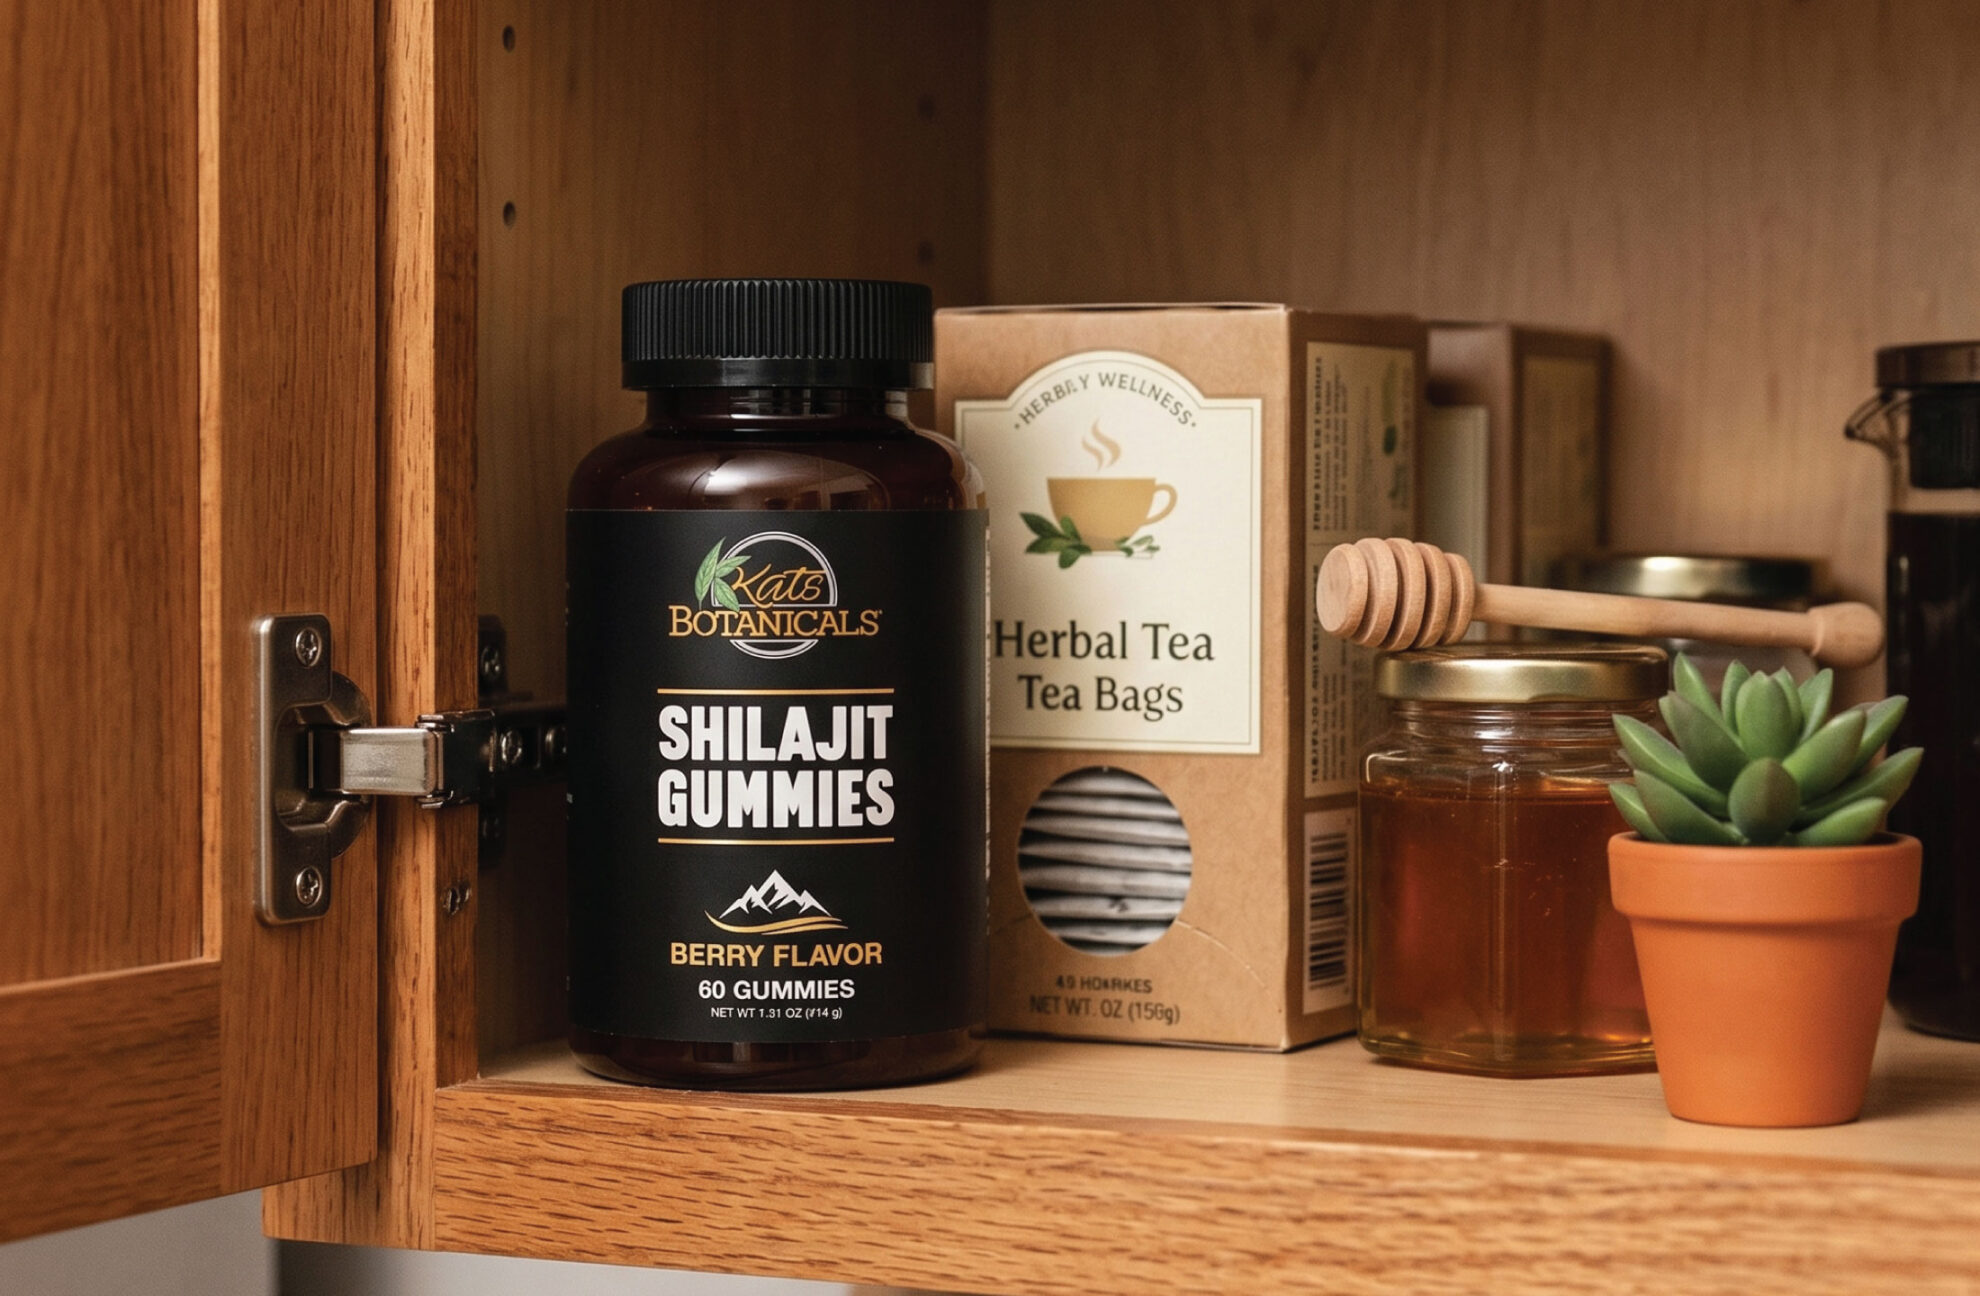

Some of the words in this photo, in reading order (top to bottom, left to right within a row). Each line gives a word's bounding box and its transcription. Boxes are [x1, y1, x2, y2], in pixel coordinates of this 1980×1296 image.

[1098, 372, 1193, 425] WELLNESS
[732, 563, 828, 608] Kats
[668, 605, 880, 637] BOTANICALS
[994, 619, 1128, 660] Herbal
[1141, 622, 1215, 661] Tea
[1017, 674, 1081, 711] Tea
[1095, 676, 1184, 722] Bags
[658, 704, 894, 761] SHILAJIT
[658, 768, 895, 828] GUMMIES
[670, 942, 764, 967] BERRY
[773, 942, 883, 967] FLAVOR
[698, 979, 726, 1000] 60
[733, 978, 856, 1000] GUMMIES
[1030, 995, 1060, 1014] NET
[711, 1007, 734, 1018] NET
[737, 1007, 756, 1018] WT
[759, 1008, 781, 1019] 1.31
[785, 1008, 802, 1019] OZ
